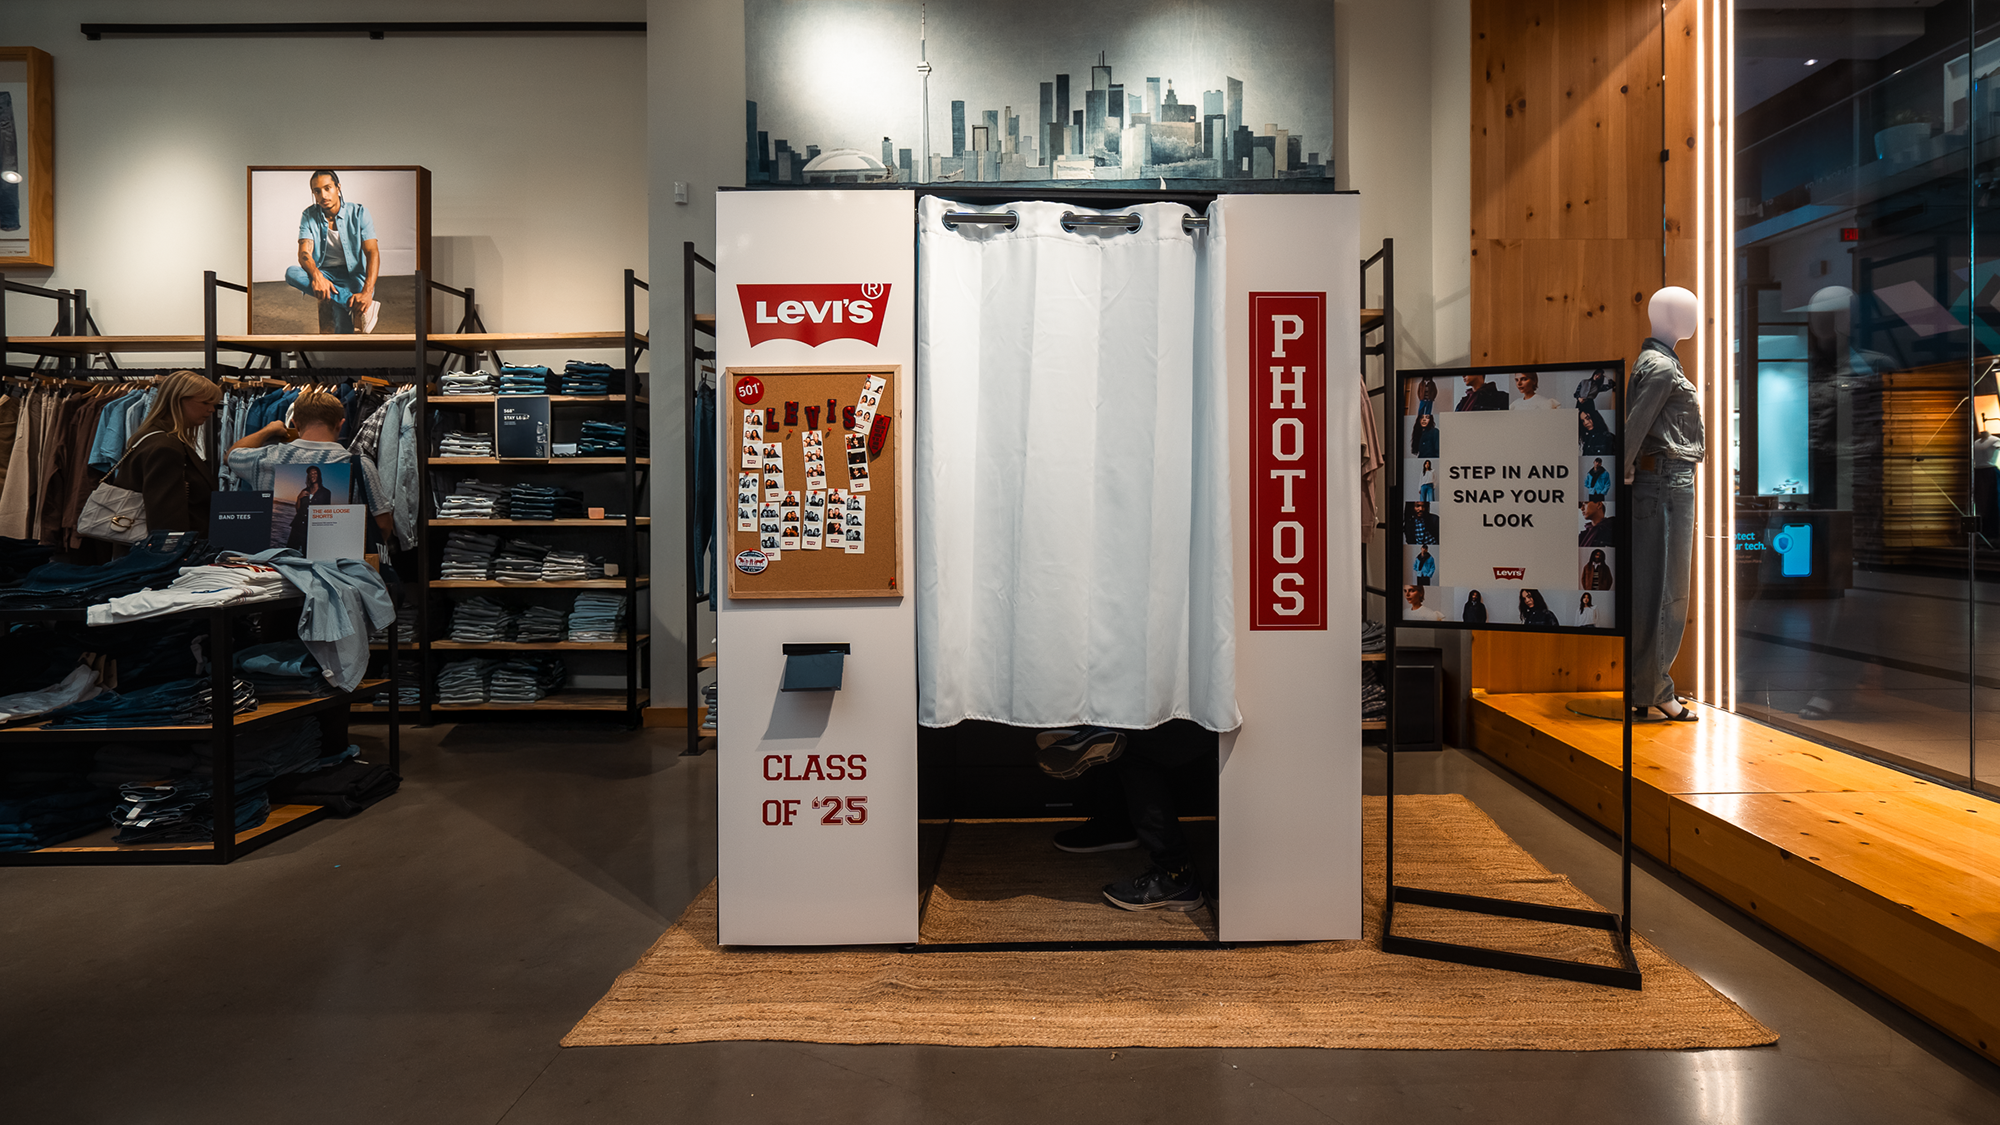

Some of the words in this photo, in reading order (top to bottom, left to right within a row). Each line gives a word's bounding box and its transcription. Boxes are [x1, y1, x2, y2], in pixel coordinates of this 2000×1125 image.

[1269, 314, 1307, 616] PHOTOS
[1449, 465, 1496, 479] STEP
[1502, 465, 1521, 479] IN
[1527, 465, 1569, 479] AND
[1453, 489, 1505, 503] SNAP
[1510, 489, 1565, 503] YOUR
[1483, 513, 1534, 527] LOOK
[1744, 541, 1766, 550] tech.
[763, 754, 867, 781] CLASS
[762, 799, 801, 826] OF
